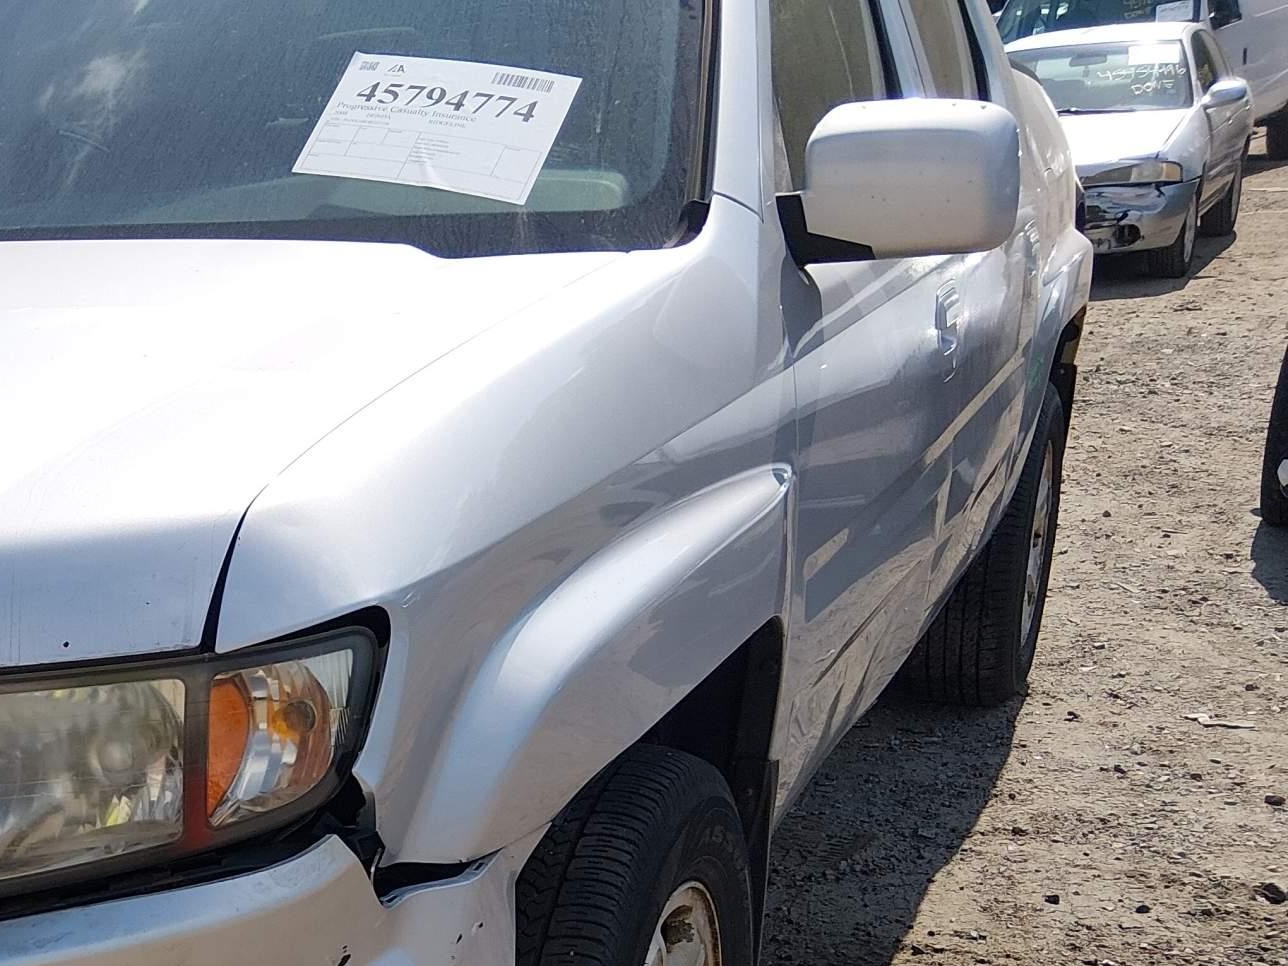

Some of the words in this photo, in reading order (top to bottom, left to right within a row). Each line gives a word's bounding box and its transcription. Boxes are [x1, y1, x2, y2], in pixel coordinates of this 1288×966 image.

[1130, 79, 1175, 95] DONE
[336, 101, 389, 113] Progressive
[389, 104, 429, 117] Casualty
[431, 110, 478, 123] Insurance
[356, 81, 539, 123] 45794774
